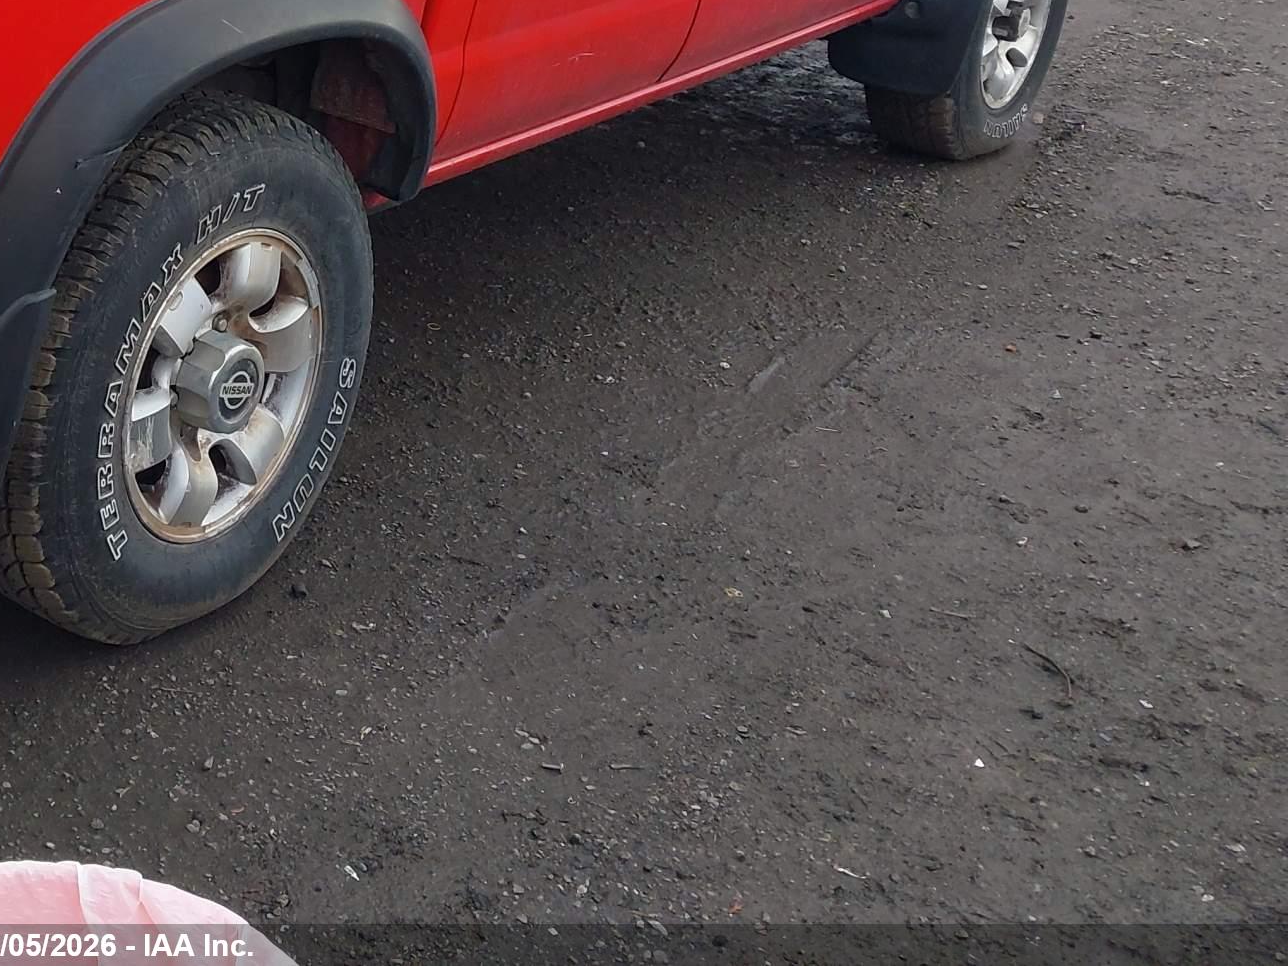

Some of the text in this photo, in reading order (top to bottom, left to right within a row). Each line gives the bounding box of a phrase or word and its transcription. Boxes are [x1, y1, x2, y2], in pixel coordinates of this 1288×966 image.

[97, 183, 266, 561] TERRAMAX H/T
[222, 384, 253, 395] NISSAN
[271, 357, 357, 541] SAILUN
